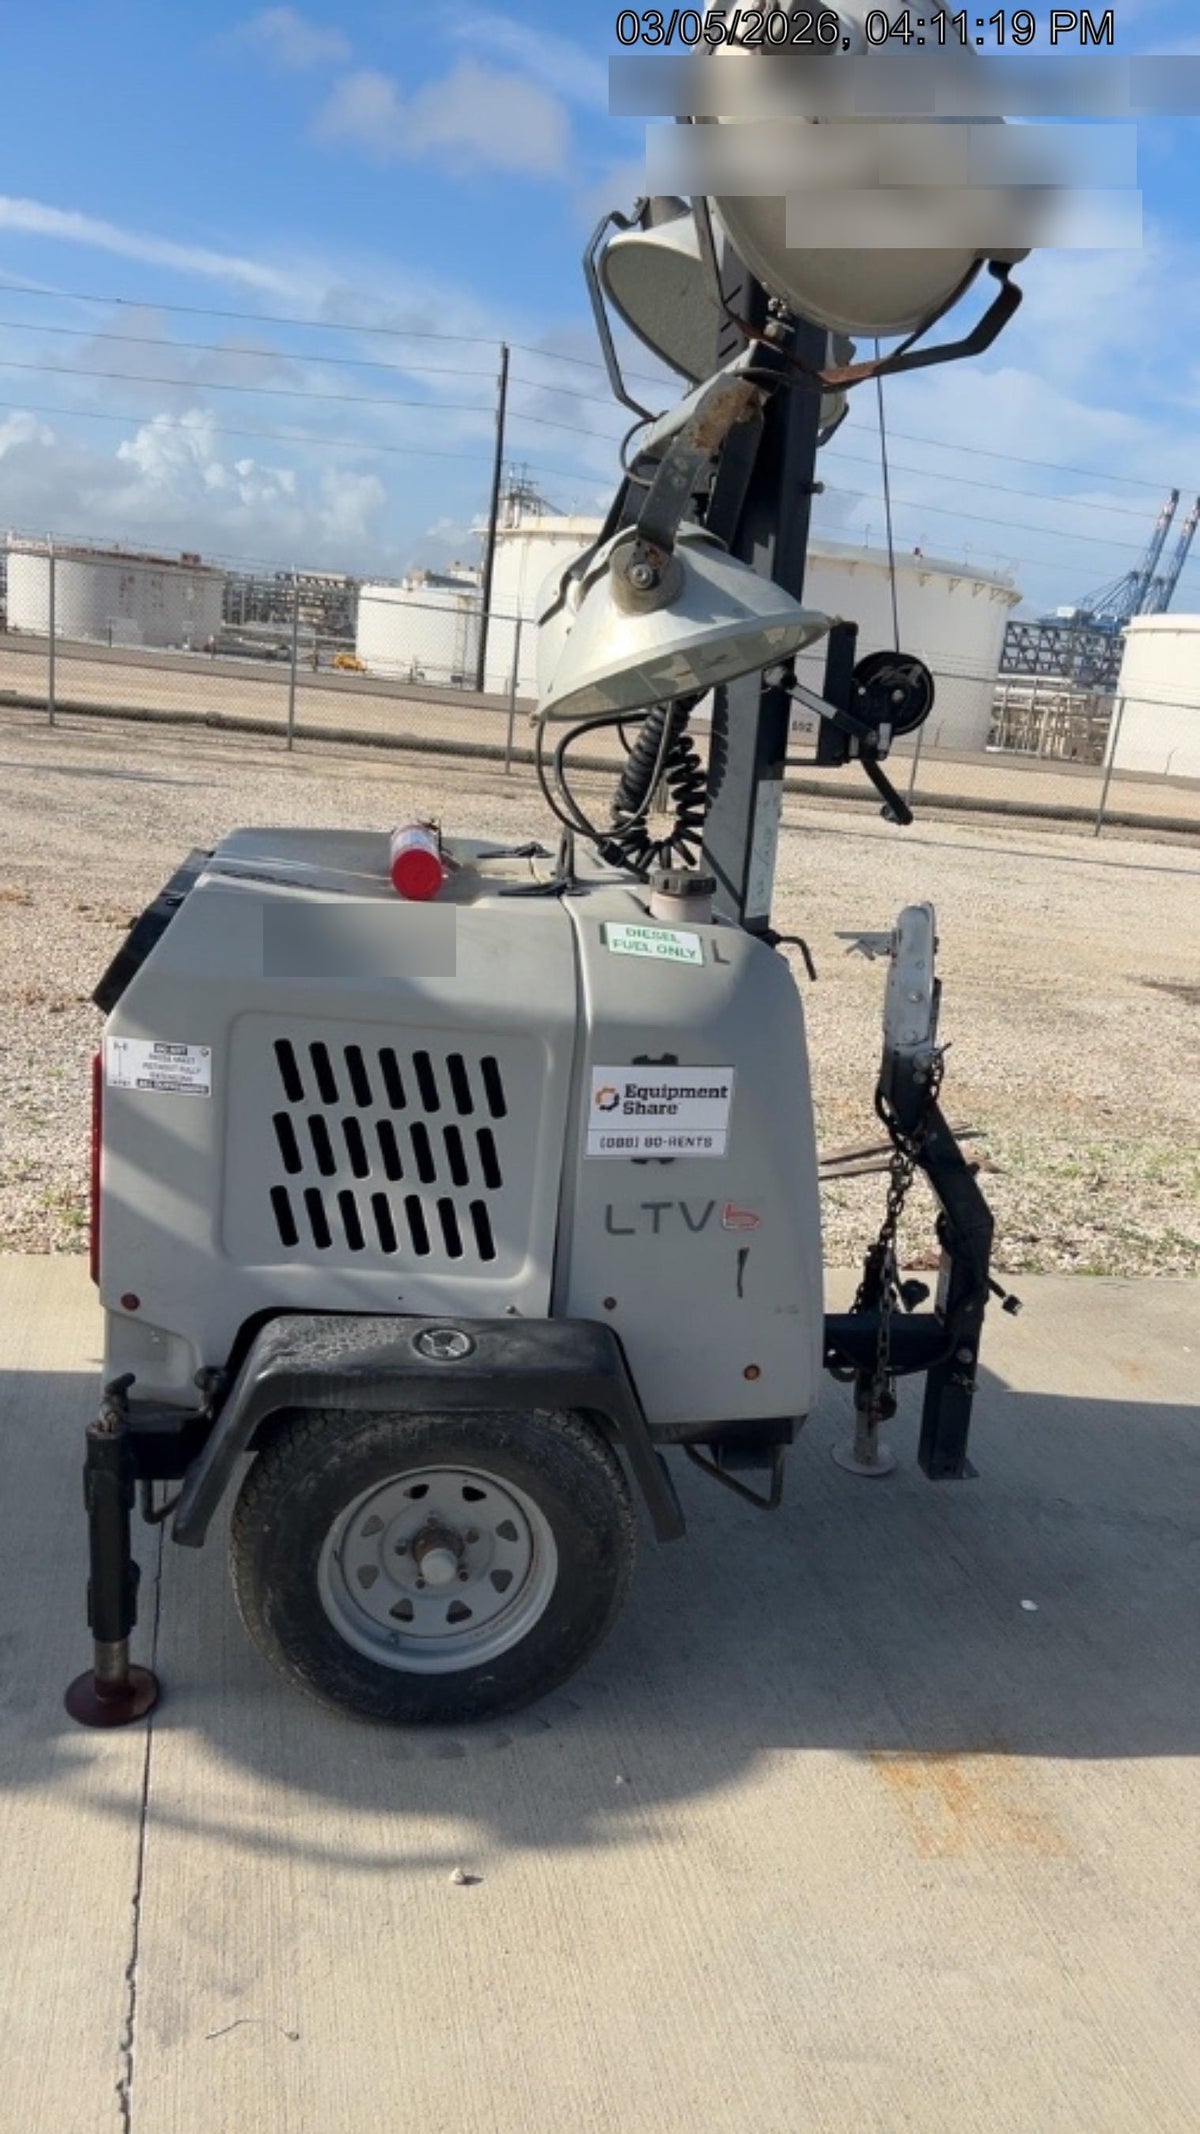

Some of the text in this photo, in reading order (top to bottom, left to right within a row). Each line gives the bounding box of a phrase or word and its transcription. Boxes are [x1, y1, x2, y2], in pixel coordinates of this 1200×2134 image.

[625, 926, 678, 944] DIESEL
[613, 938, 697, 959] FUEL ONLY
[624, 1083, 728, 1101] Equipment
[623, 1100, 679, 1116] Share
